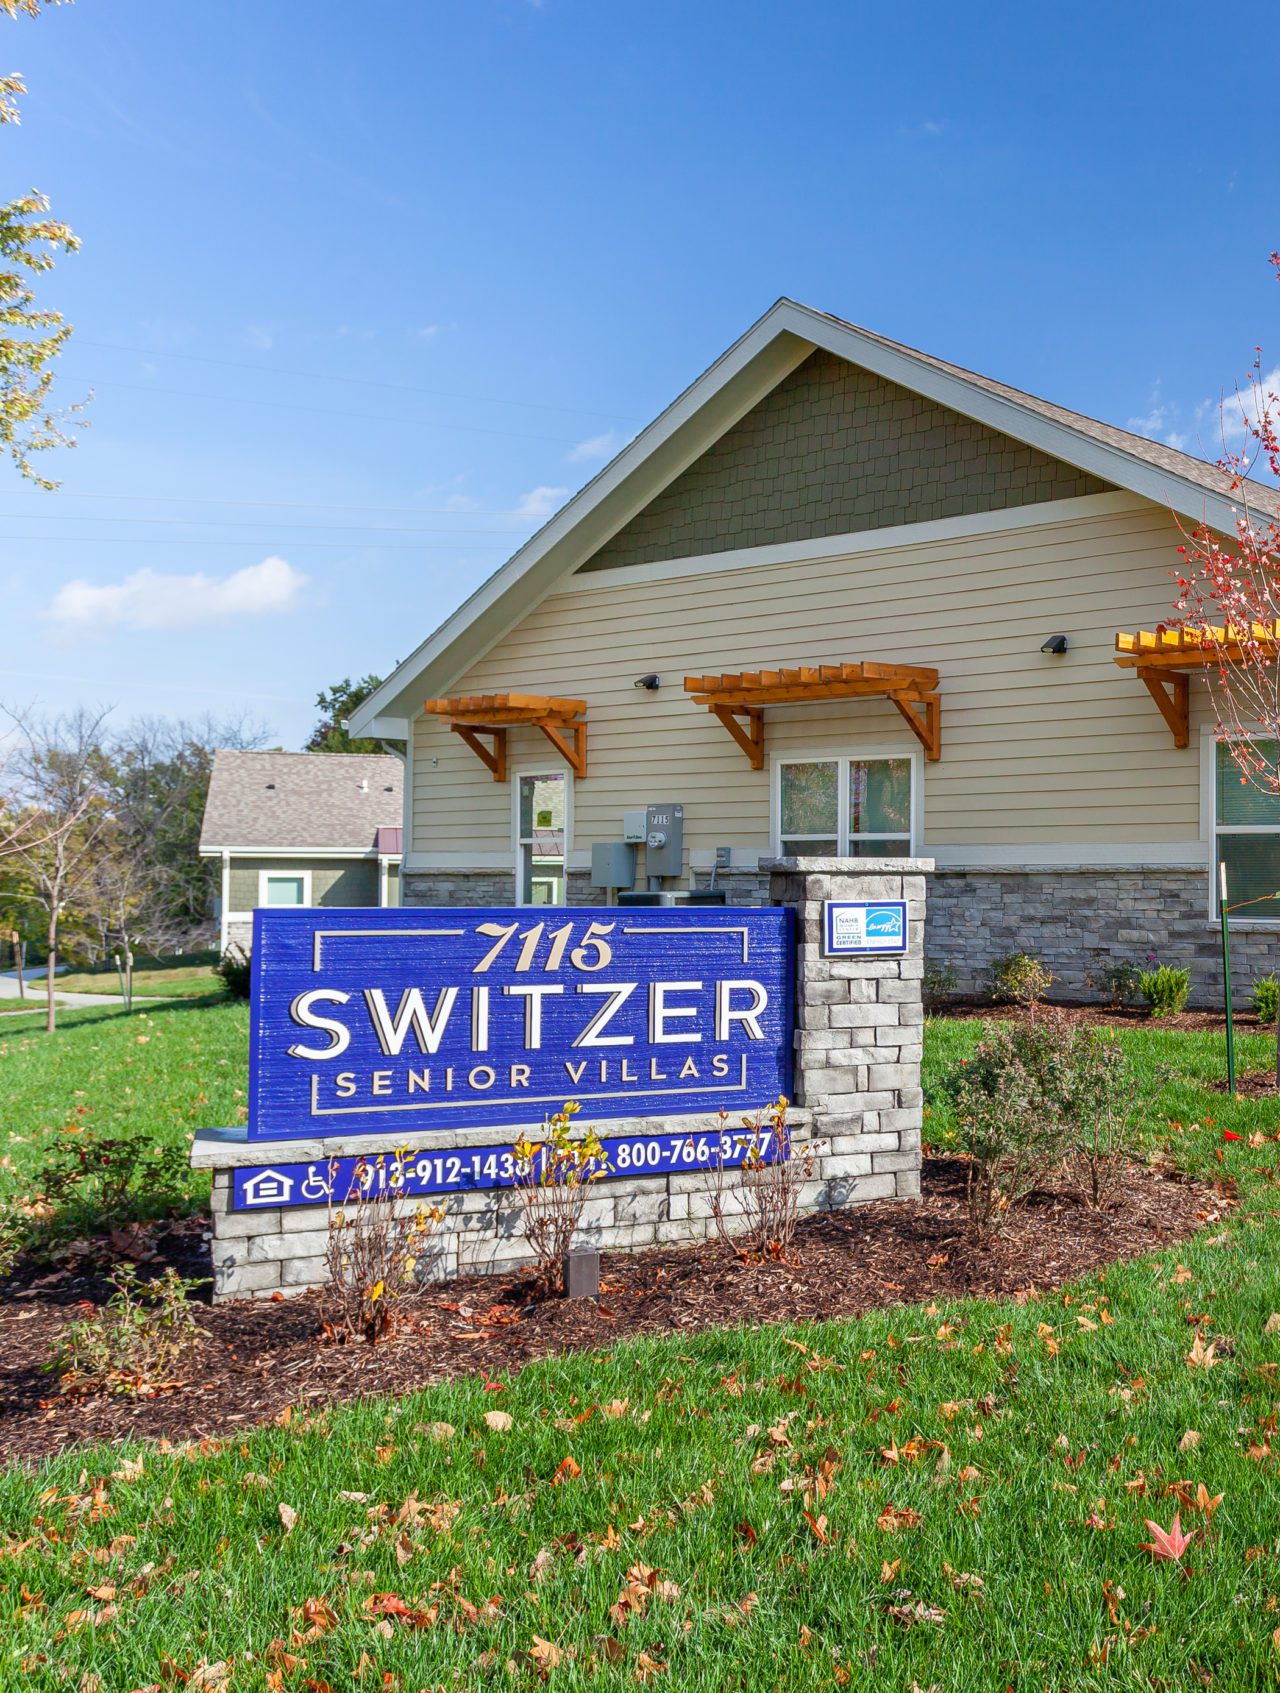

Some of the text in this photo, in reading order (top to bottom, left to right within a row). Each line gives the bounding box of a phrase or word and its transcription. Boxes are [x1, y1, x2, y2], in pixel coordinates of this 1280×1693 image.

[651, 815, 669, 824] 7115
[472, 922, 616, 973] 7115
[287, 979, 768, 1060] SWITZER
[335, 1054, 729, 1098] SENIOR VILLAS
[616, 1132, 772, 1168] 800-766-3777
